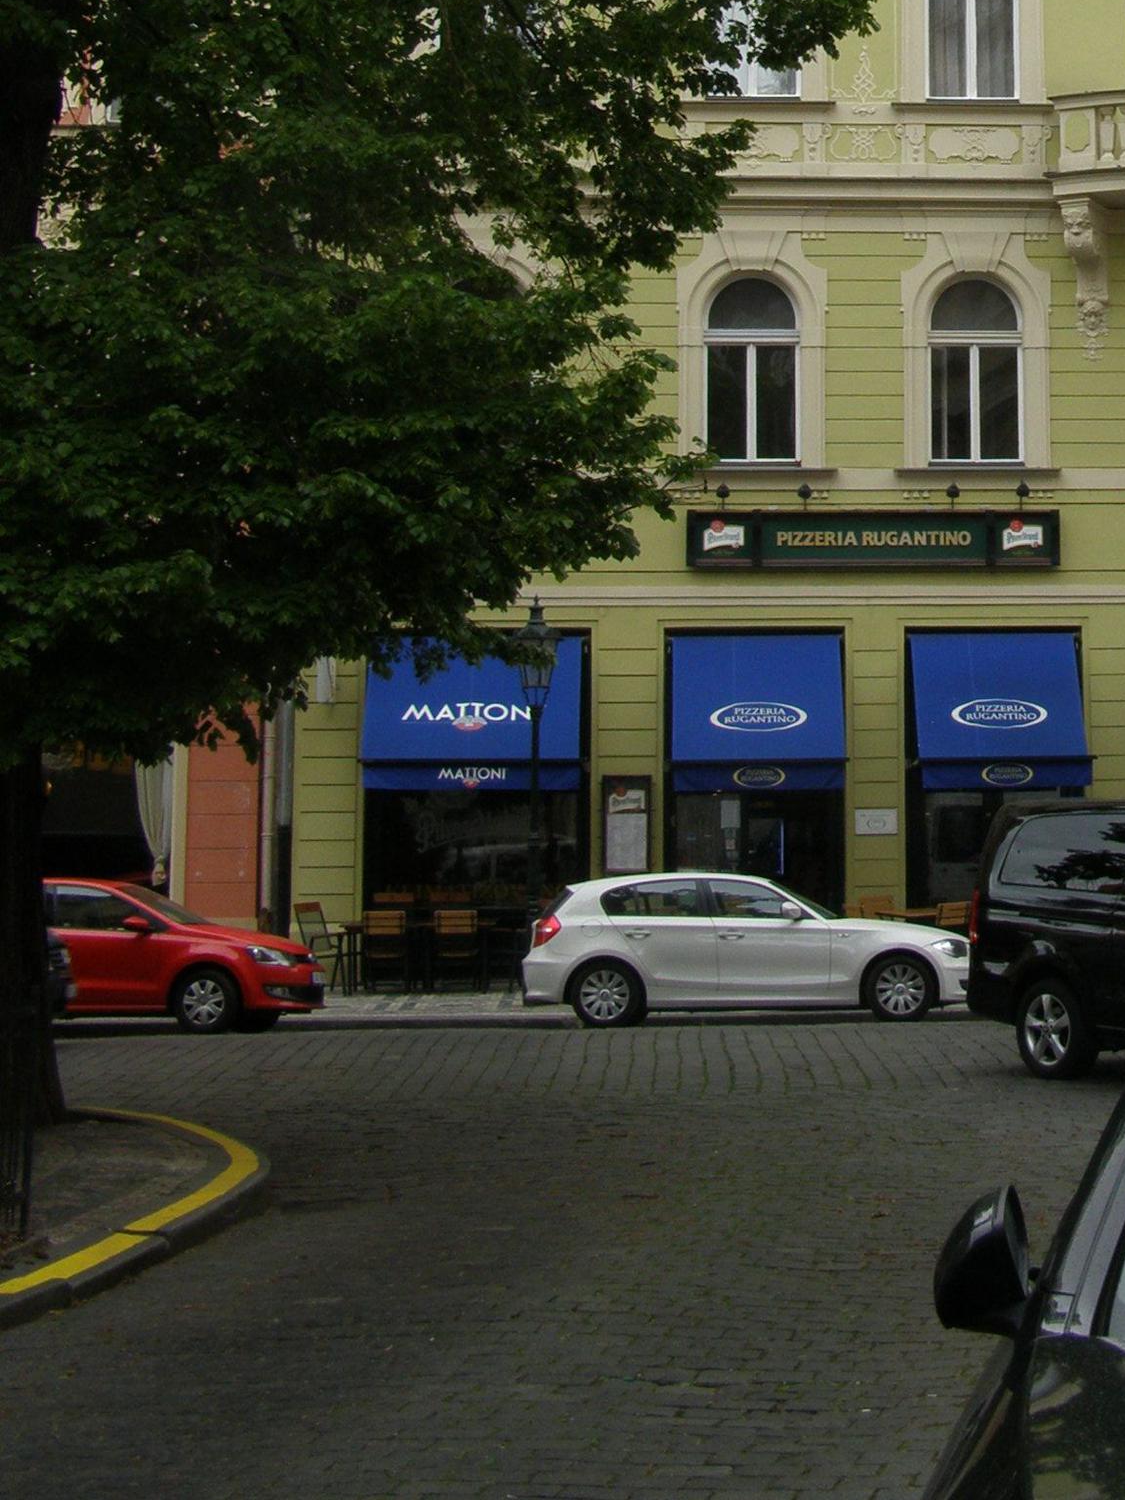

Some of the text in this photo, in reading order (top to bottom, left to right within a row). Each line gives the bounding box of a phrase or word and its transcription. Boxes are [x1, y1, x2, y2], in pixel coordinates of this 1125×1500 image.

[776, 531, 972, 547] PIZZERIA RUGANTINO
[401, 702, 531, 721] MATTON
[734, 707, 786, 715] PIZZERIA
[975, 704, 1027, 712] PIZZERIA
[724, 714, 797, 724] RUGANTINO
[966, 712, 1038, 721] RUGANTINO
[438, 767, 506, 780] MATTONI
